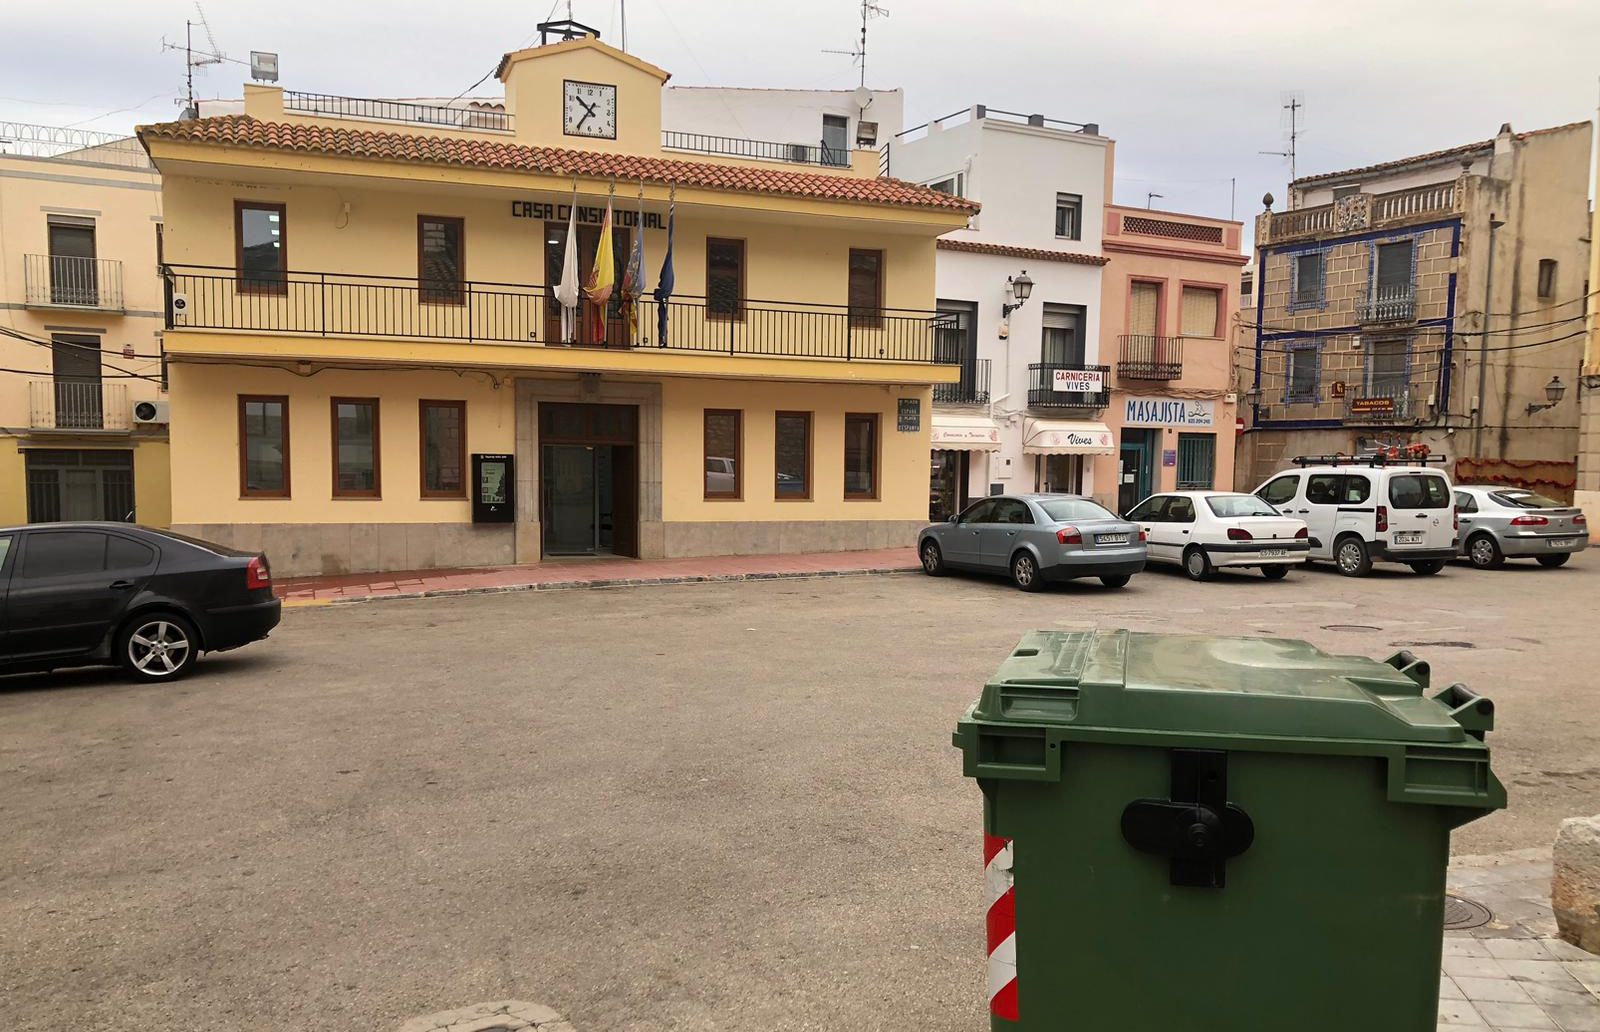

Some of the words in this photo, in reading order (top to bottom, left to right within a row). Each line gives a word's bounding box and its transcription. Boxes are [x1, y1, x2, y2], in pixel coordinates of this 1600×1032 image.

[512, 201, 553, 219] CASA
[557, 204, 667, 230] CNSITORIAL
[1055, 371, 1101, 382] CARNICERIA
[1066, 381, 1091, 391] VIVES
[1126, 400, 1186, 423] MASAJISTA
[1067, 433, 1092, 445] Vives
